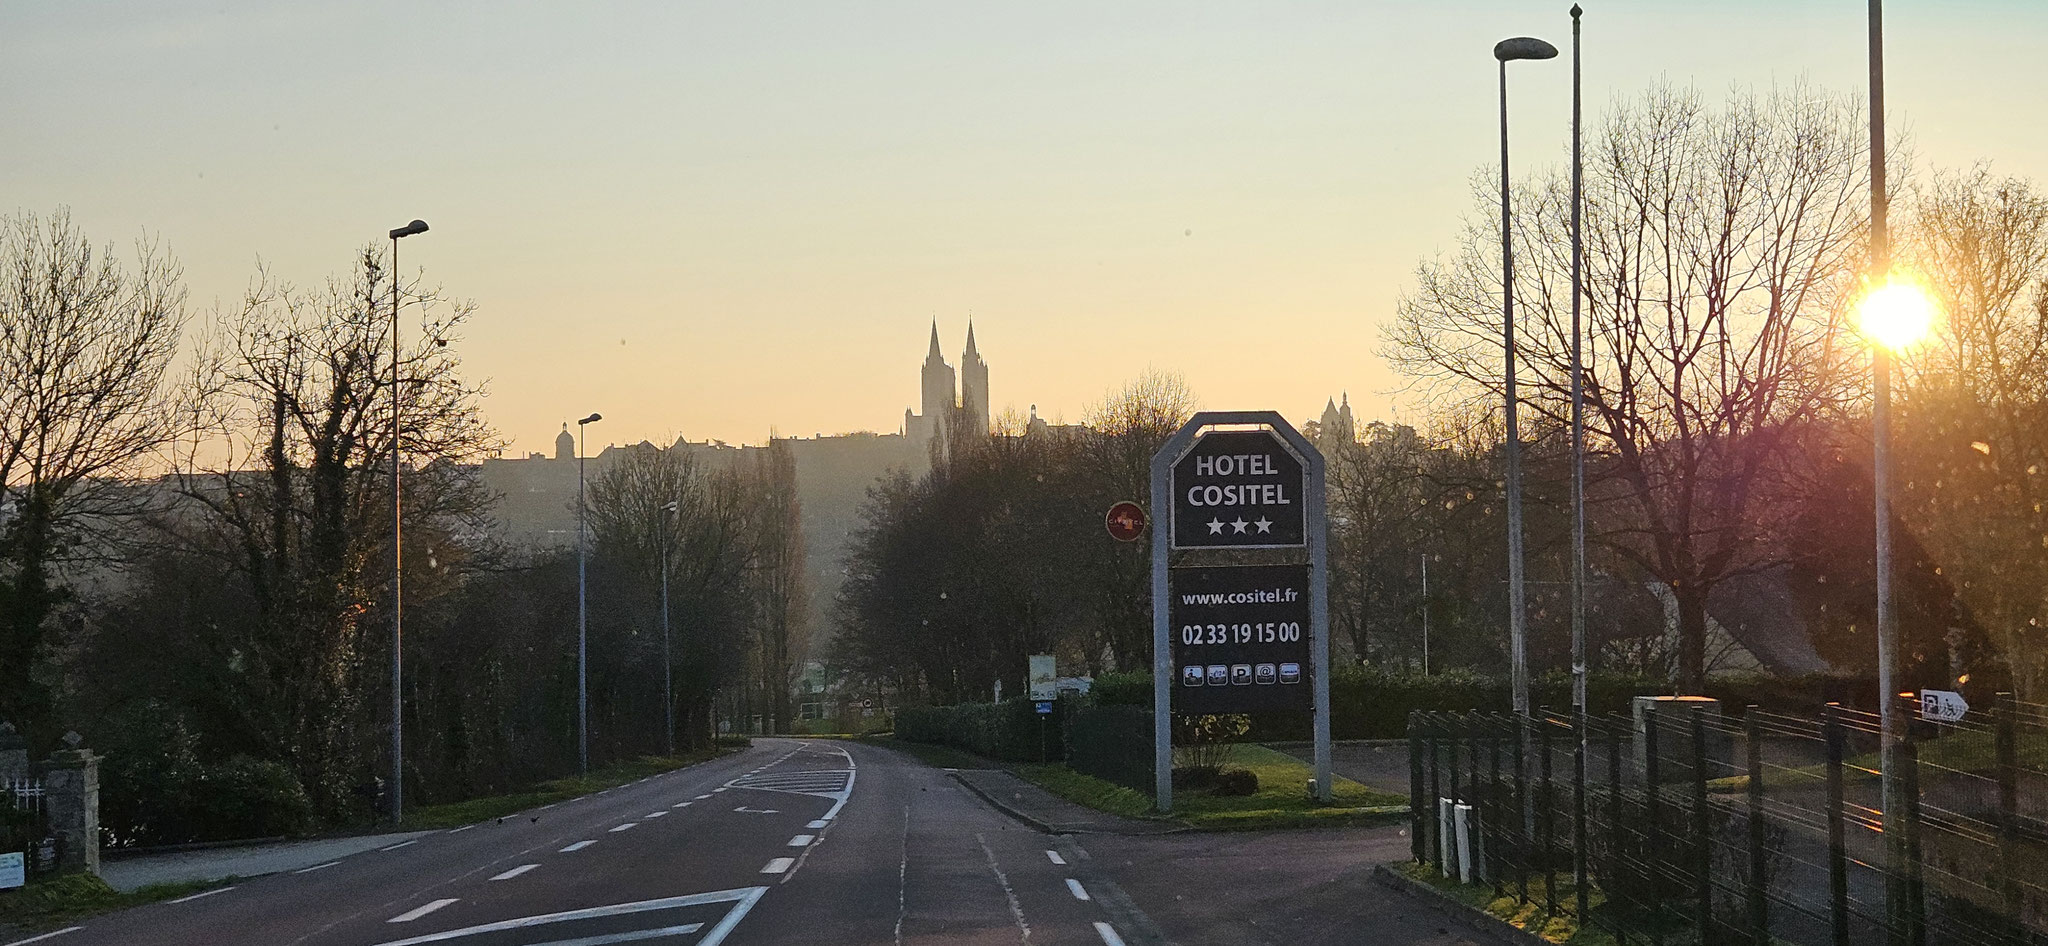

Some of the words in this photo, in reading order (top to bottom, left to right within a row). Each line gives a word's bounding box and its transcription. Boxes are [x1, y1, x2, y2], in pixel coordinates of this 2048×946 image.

[1196, 454, 1278, 476] HOTEL
[1187, 484, 1290, 506] COSITEL
[1182, 587, 1298, 605] www.cositel.fr
[1182, 624, 1203, 645] 02
[1206, 624, 1227, 645] 33
[1231, 623, 1252, 644] 19
[1255, 622, 1275, 643] 15
[1278, 621, 1300, 642] 00
